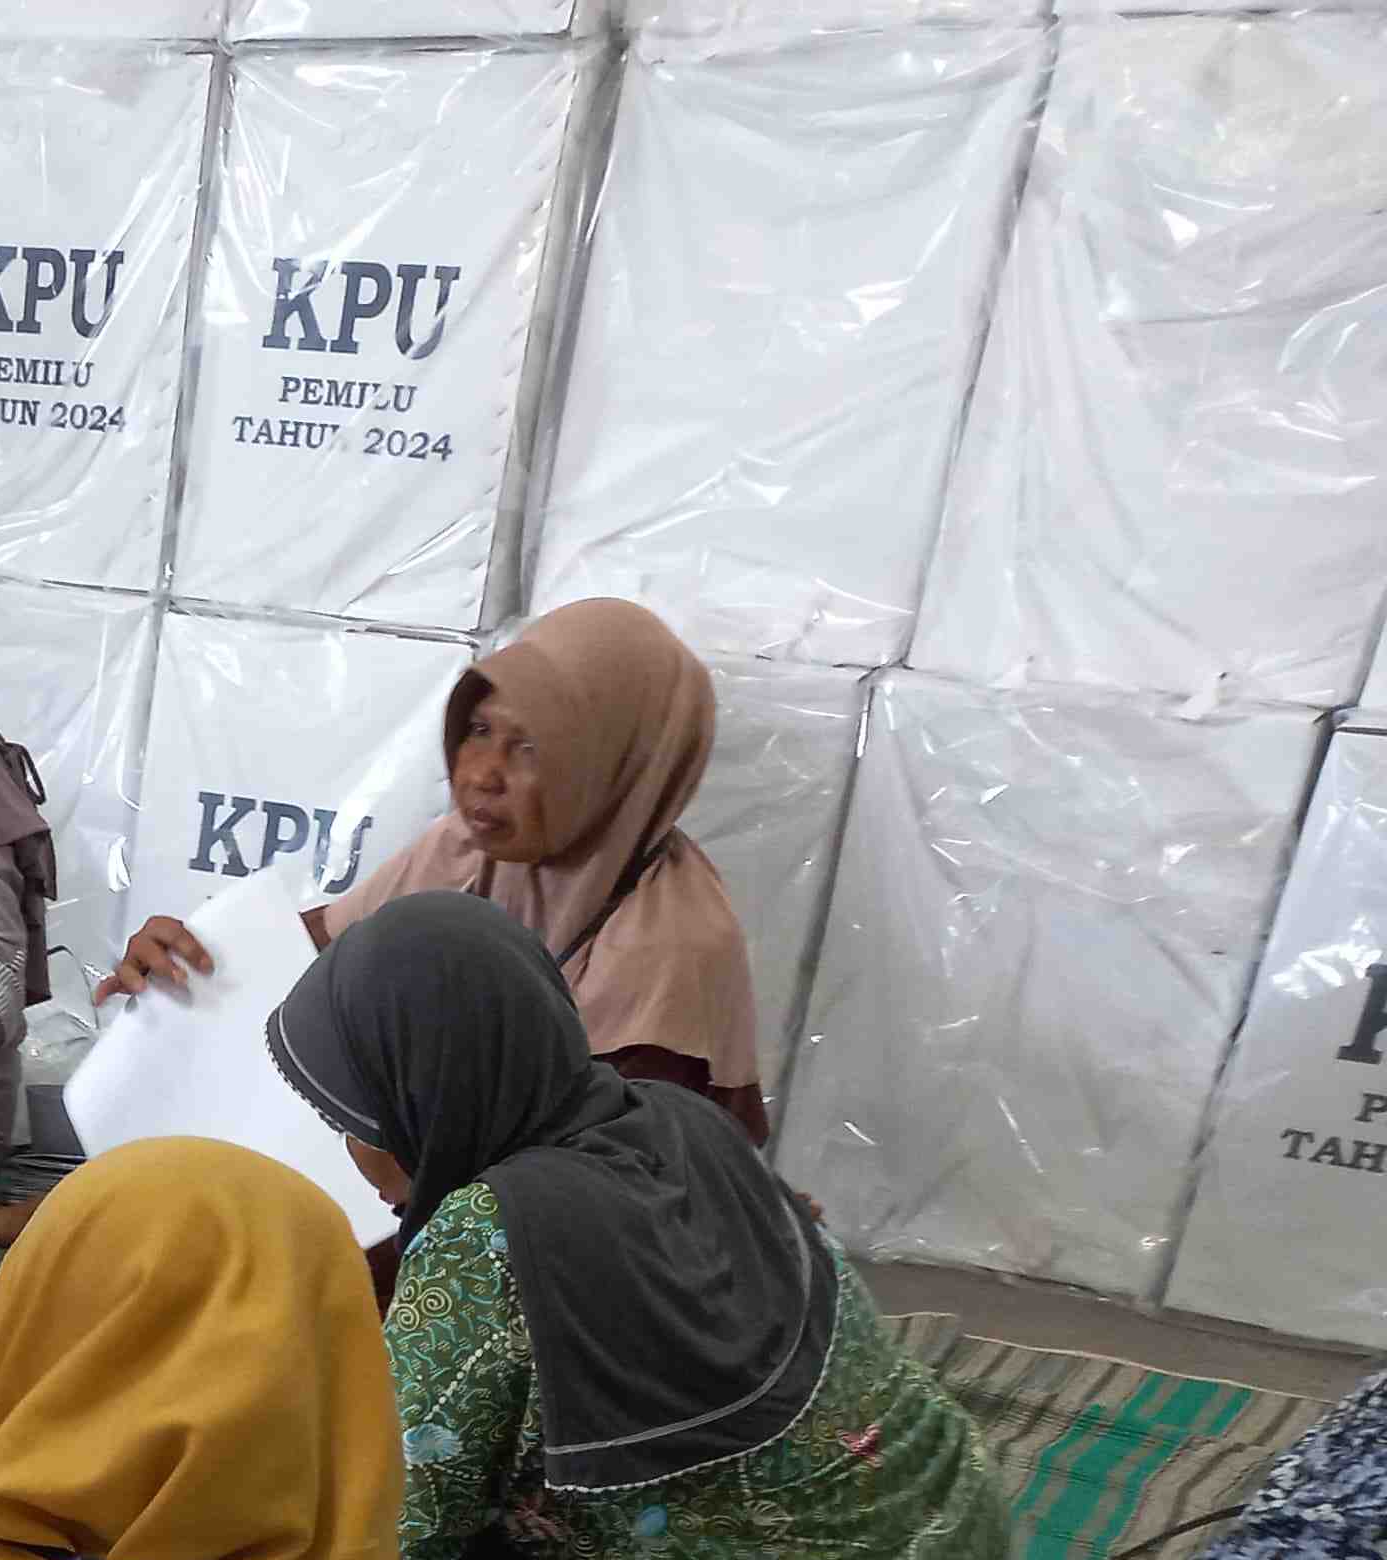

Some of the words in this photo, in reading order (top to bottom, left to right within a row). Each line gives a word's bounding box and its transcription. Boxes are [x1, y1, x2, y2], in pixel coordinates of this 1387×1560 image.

[262, 257, 462, 360] KPU
[50, 401, 127, 432] 2024
[363, 427, 454, 462] 2024
[188, 791, 374, 895] KPU
